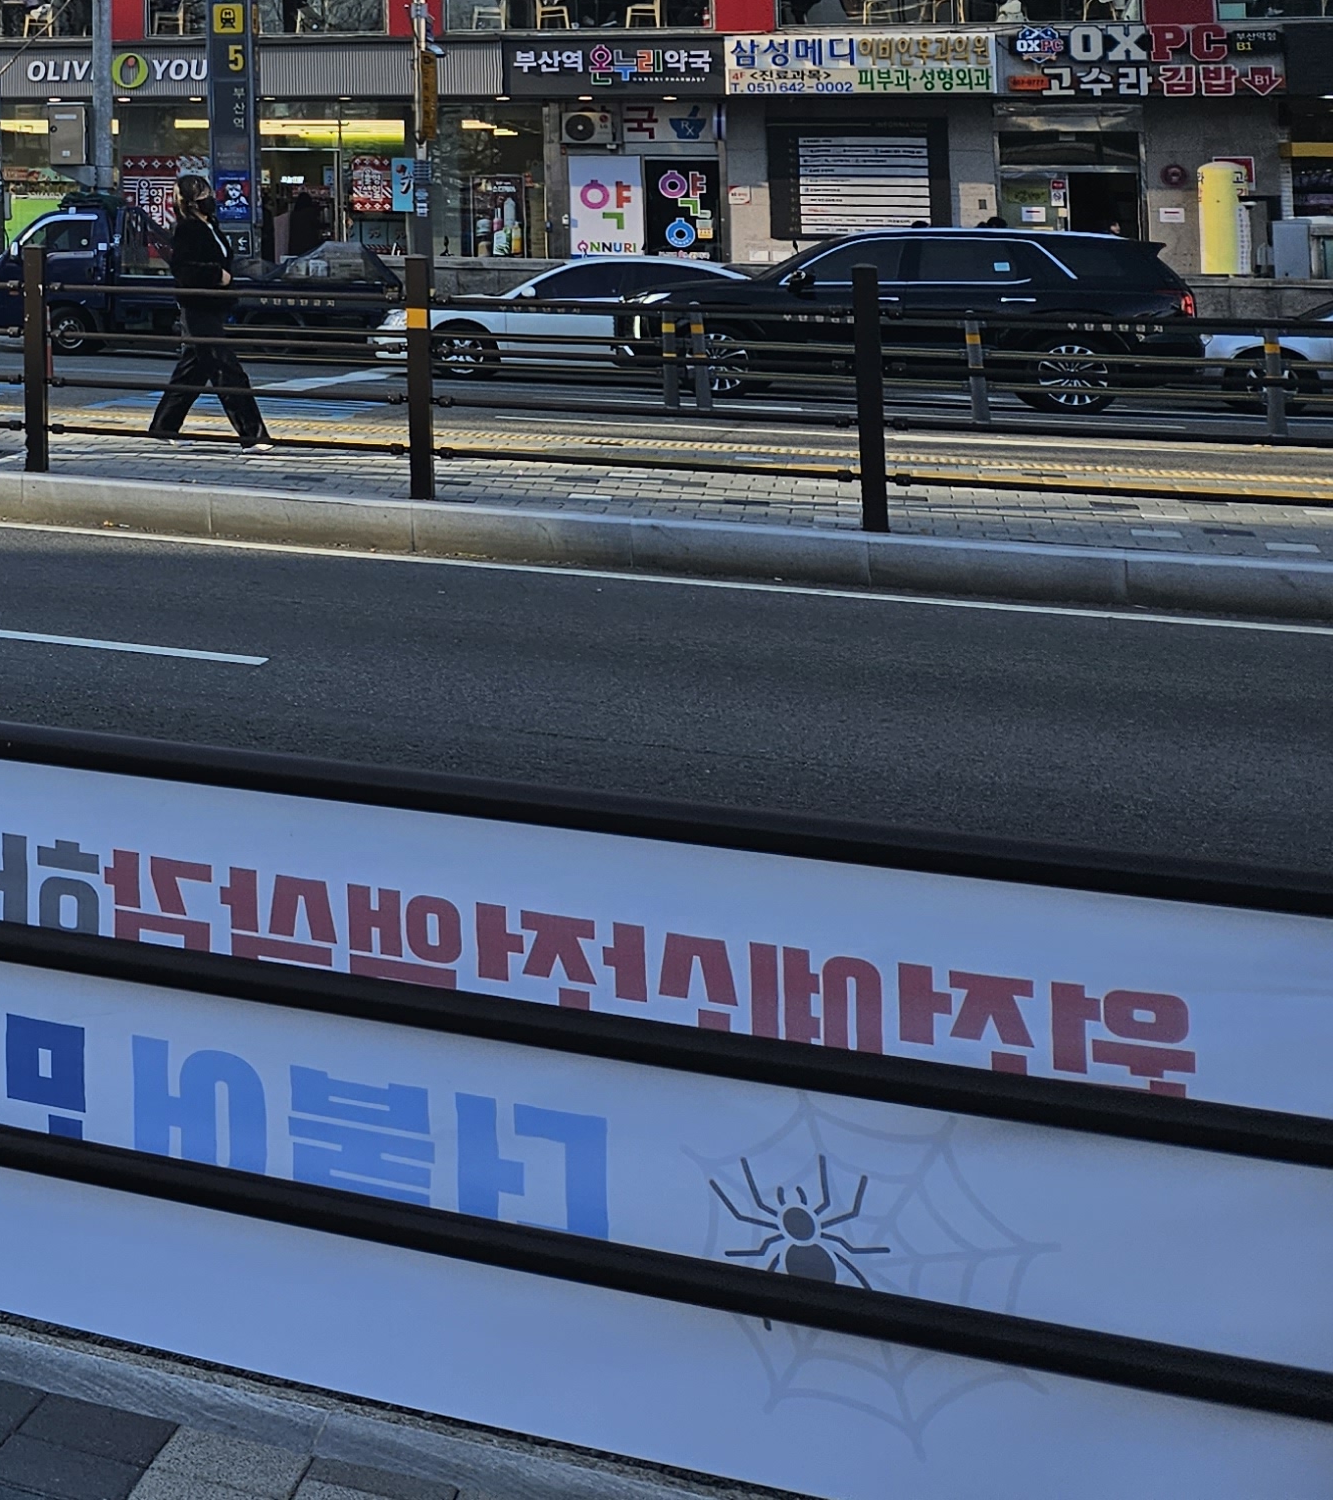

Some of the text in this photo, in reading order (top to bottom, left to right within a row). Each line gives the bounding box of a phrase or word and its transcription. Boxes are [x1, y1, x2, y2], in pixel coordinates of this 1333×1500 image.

[228, 44, 244, 71] 5
[1236, 40, 1253, 51] B1
[27, 58, 208, 82] OLIV YOU
[513, 50, 584, 73] 부산역
[732, 72, 746, 80] 4F
[1041, 64, 1272, 97] 고수라 김밥 B1
[232, 87, 245, 129] 부산역
